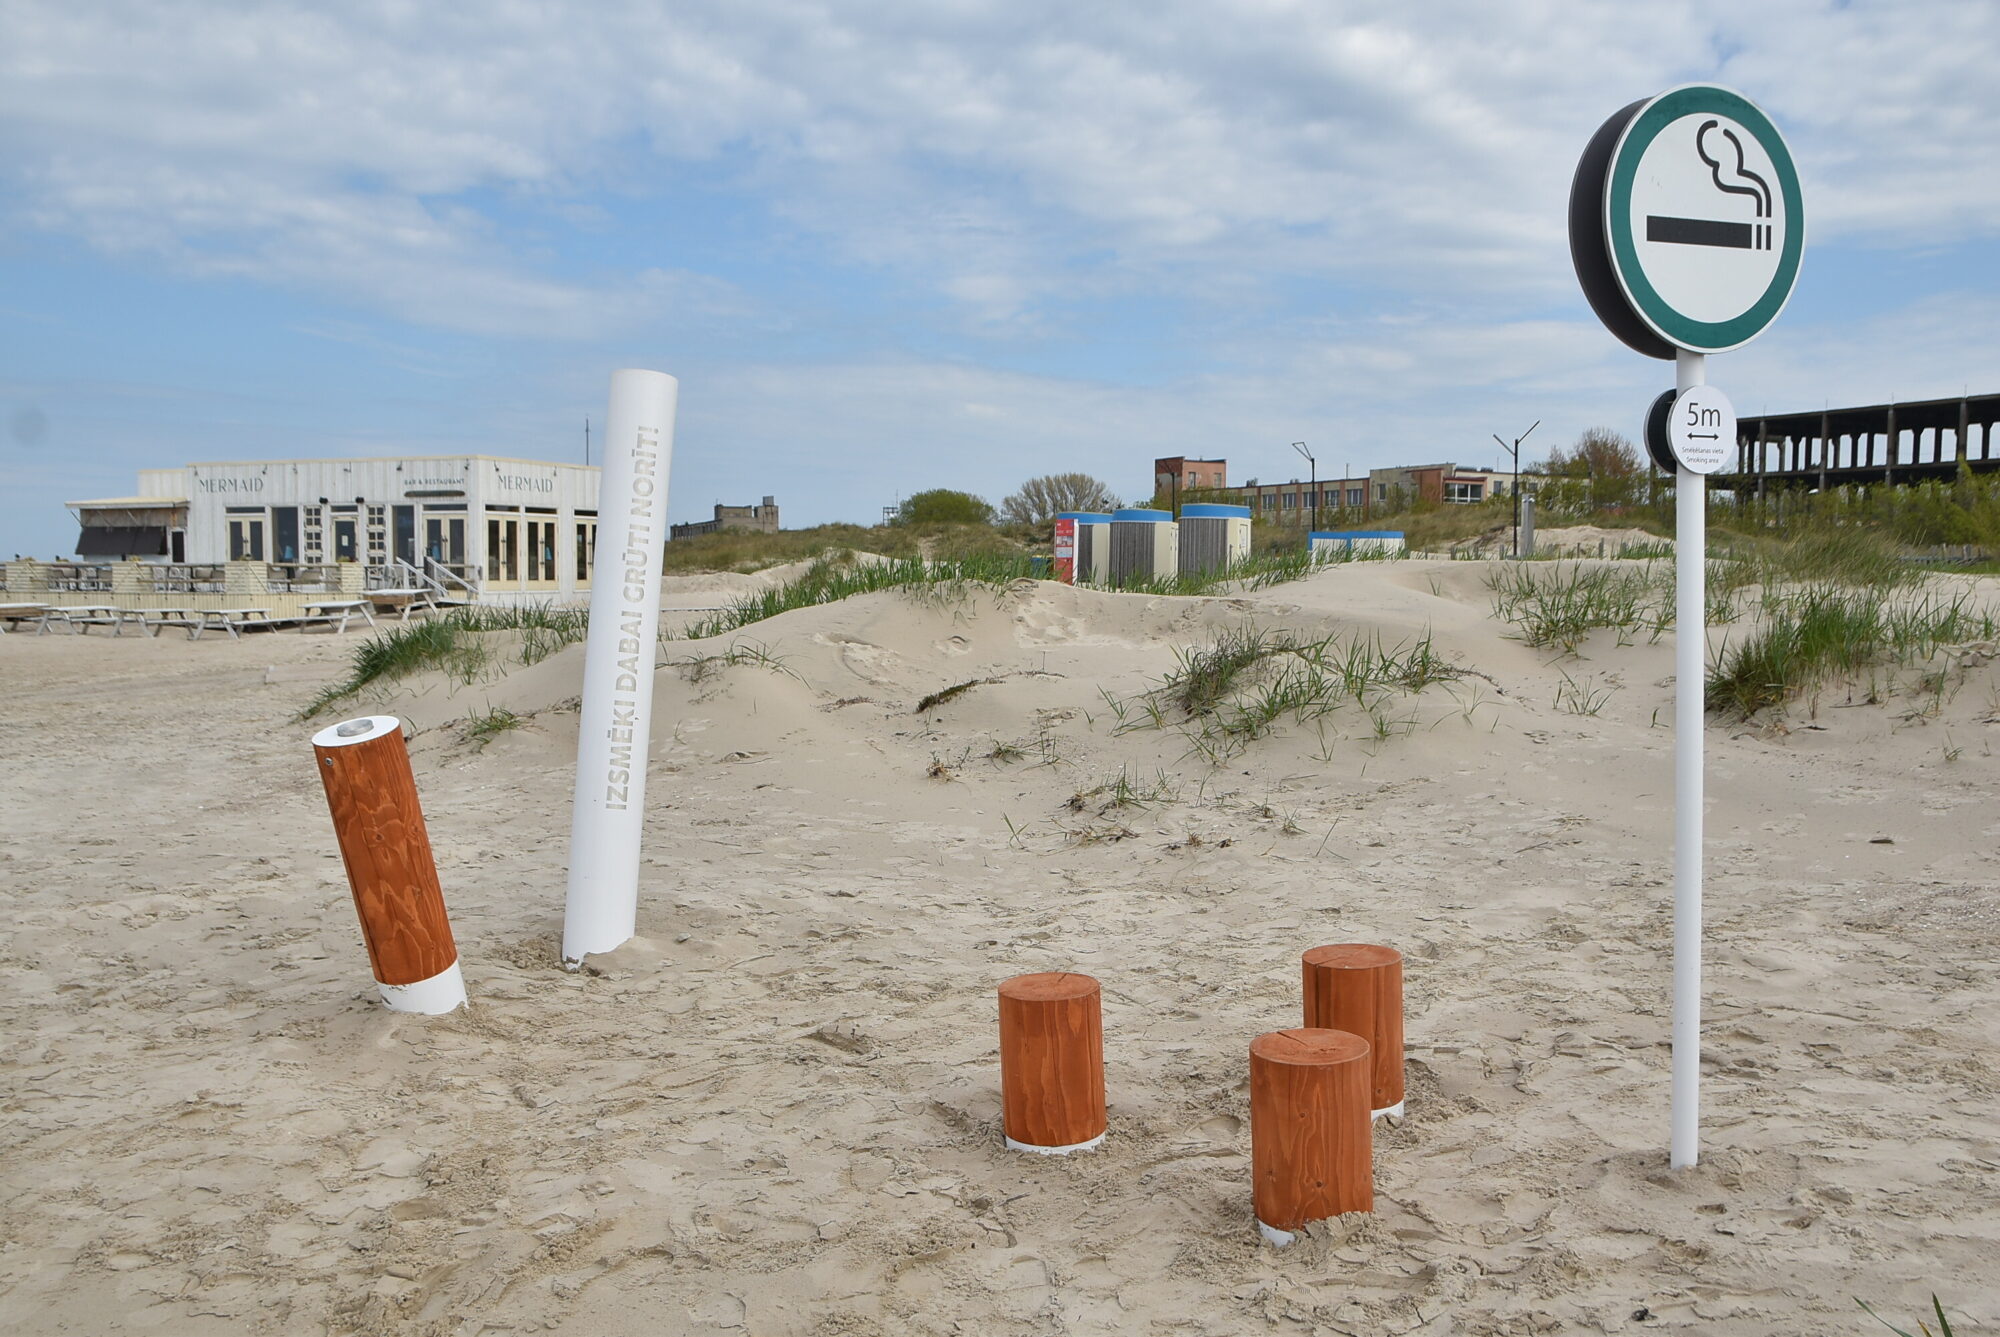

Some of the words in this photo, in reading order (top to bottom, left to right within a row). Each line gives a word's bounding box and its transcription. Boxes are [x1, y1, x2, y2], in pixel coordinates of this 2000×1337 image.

[1687, 402, 1721, 427] 5m
[199, 478, 264, 493] MERMAID
[498, 475, 553, 493] MERMAID
[630, 425, 659, 518] NORĪT!
[1686, 456, 1708, 464] Smoking
[622, 523, 651, 603] GRŪTI
[615, 610, 643, 692] DABAI
[605, 699, 640, 811] IZSMĒĶI
